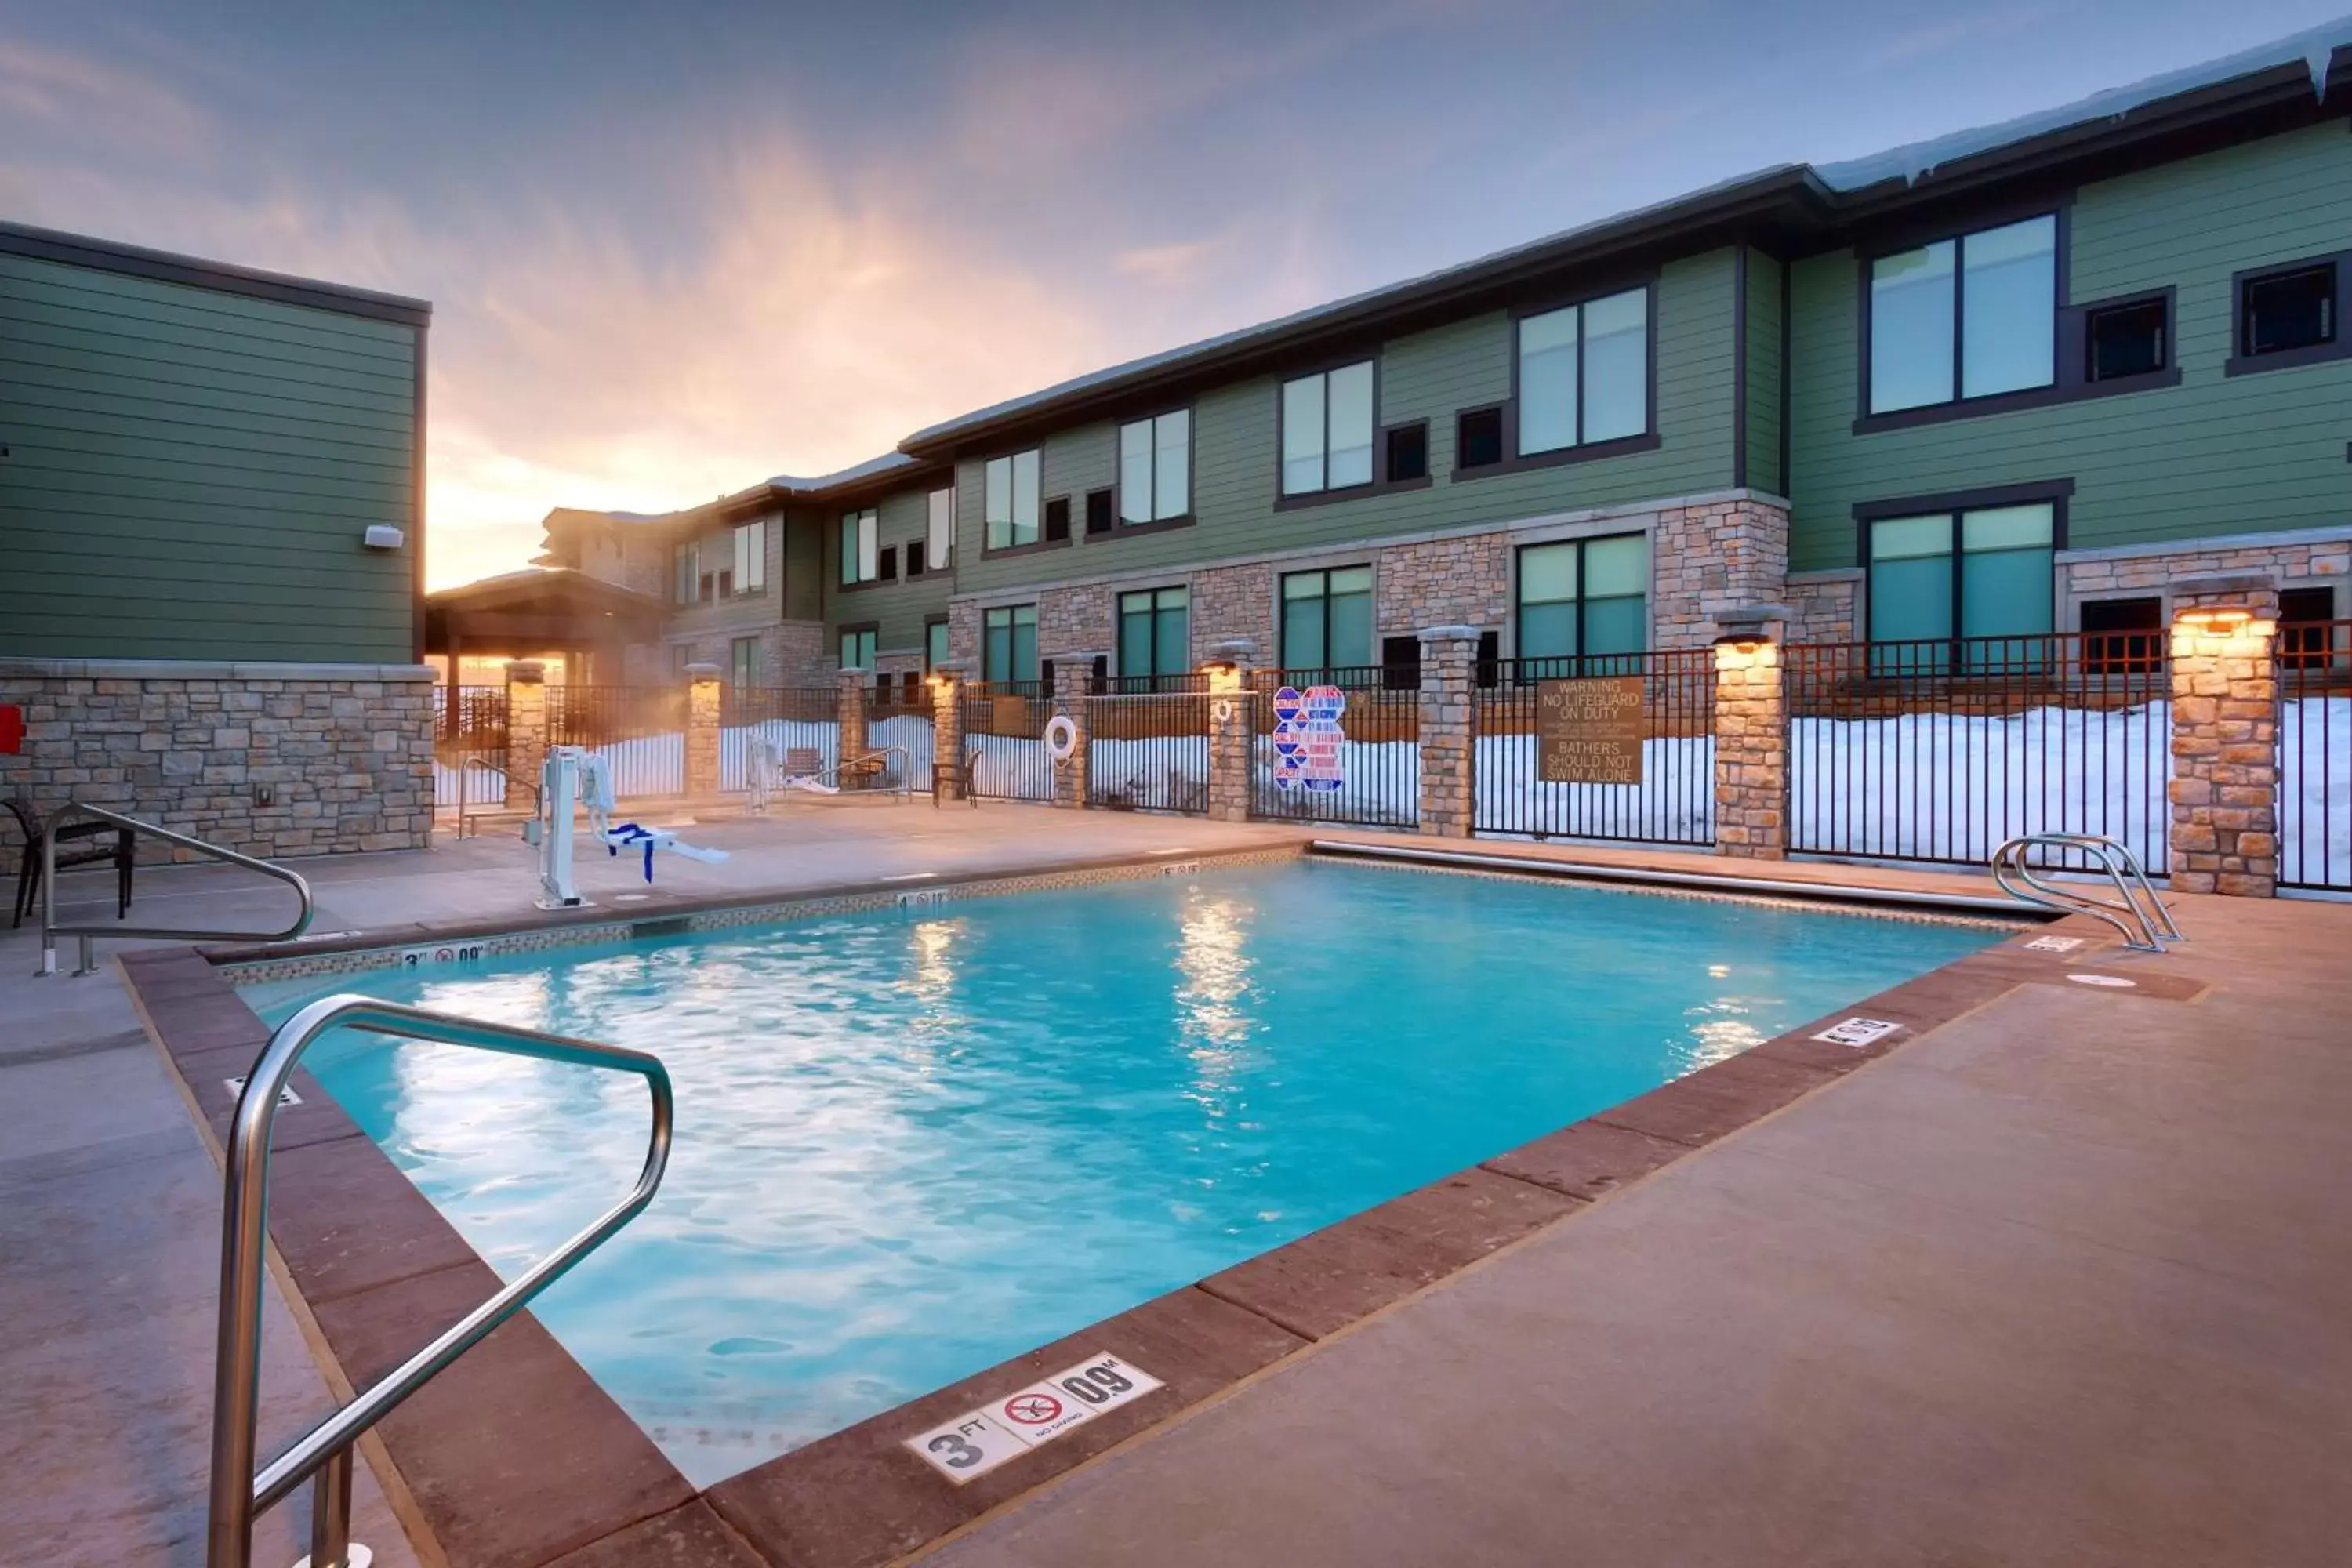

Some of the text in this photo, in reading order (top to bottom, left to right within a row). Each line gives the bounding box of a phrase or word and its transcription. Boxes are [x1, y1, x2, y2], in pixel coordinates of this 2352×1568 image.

[1559, 681, 1621, 693] WARNING
[1544, 693, 1639, 707] NO LIFEGUARD
[1560, 706, 1619, 720] ON DUTY
[1559, 742, 1620, 755] BATHERS
[1547, 753, 1632, 768] SHOULD NOT
[1548, 767, 1632, 782] SWIM ALONE
[1036, 1428, 1051, 1437] NO
[928, 1434, 984, 1468] 3
